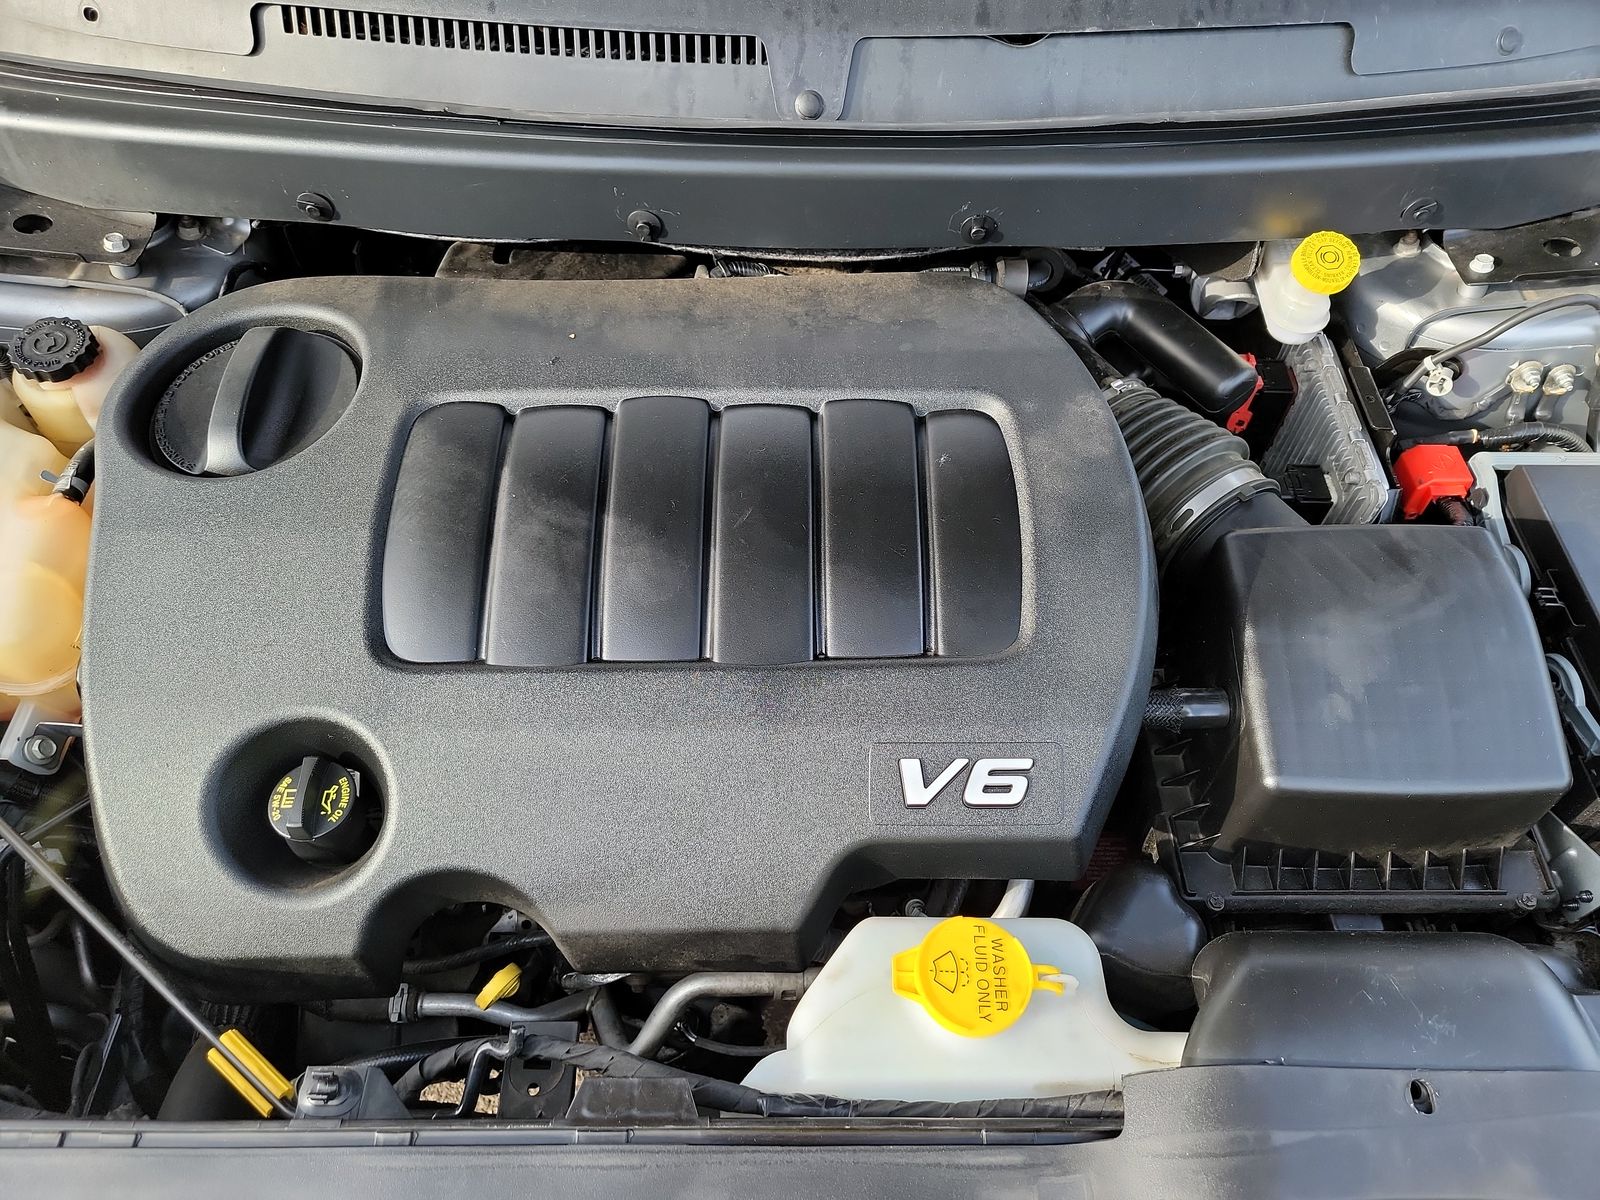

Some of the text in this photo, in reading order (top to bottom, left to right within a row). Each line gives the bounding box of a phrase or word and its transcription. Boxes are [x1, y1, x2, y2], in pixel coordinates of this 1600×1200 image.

[271, 776, 293, 822] SAE 5W-20
[327, 776, 350, 823] ENGINE OIL
[899, 758, 1035, 810] V6
[973, 924, 993, 1023] FLUID ONLY
[991, 938, 1009, 1012] WASHER
